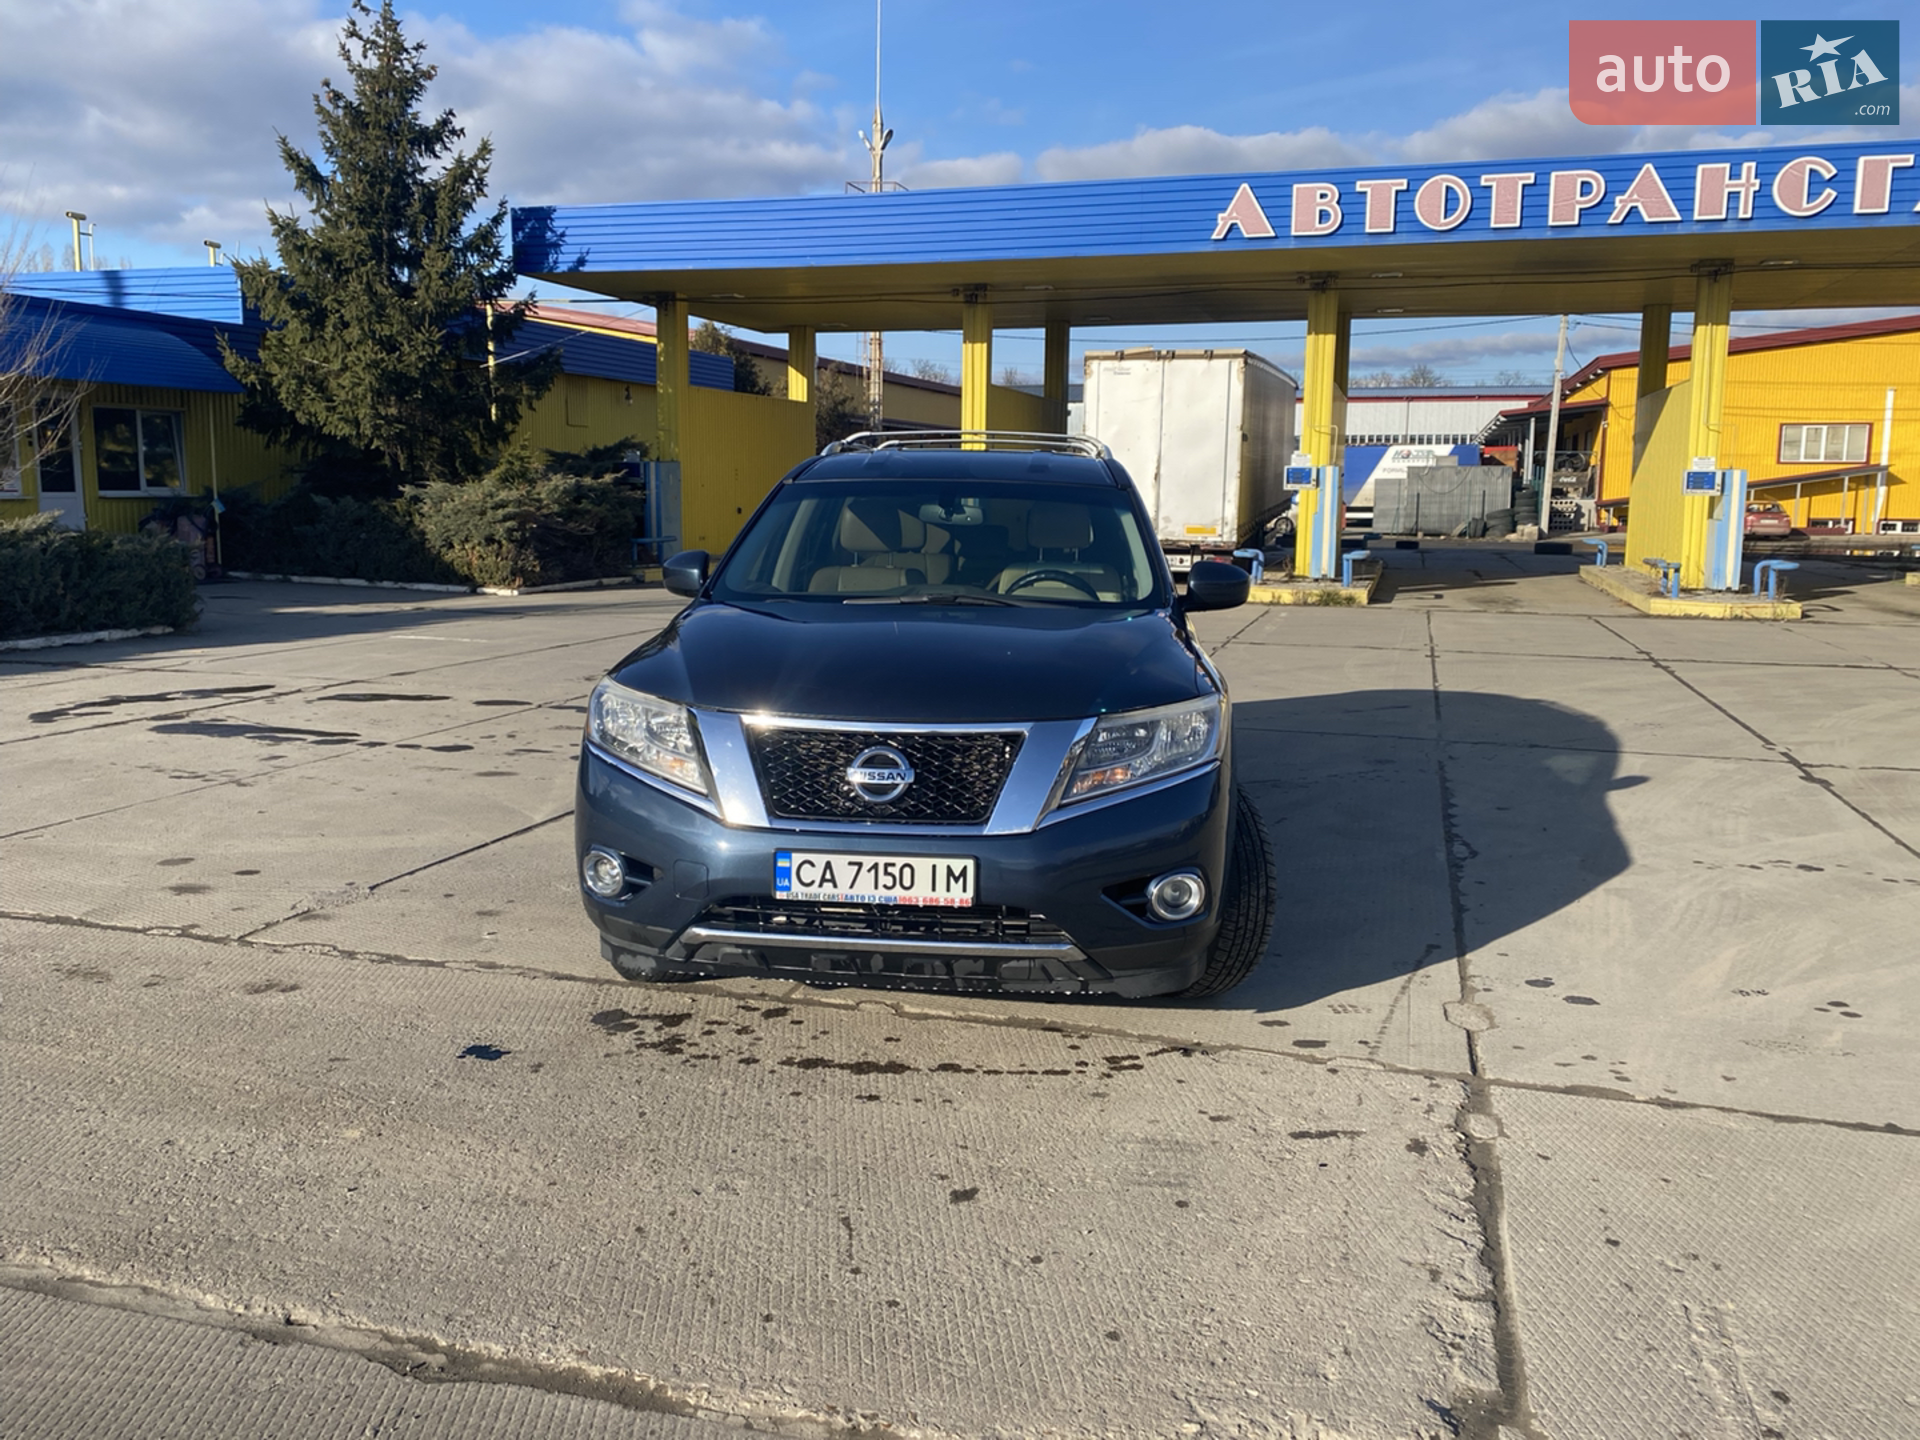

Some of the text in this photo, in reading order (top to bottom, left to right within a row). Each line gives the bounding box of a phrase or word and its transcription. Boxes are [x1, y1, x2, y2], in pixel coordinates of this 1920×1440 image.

[1211, 153, 1920, 239] АВТОТРАНСГ
[776, 877, 790, 887] UA
[796, 859, 968, 893] CA 7150 IM
